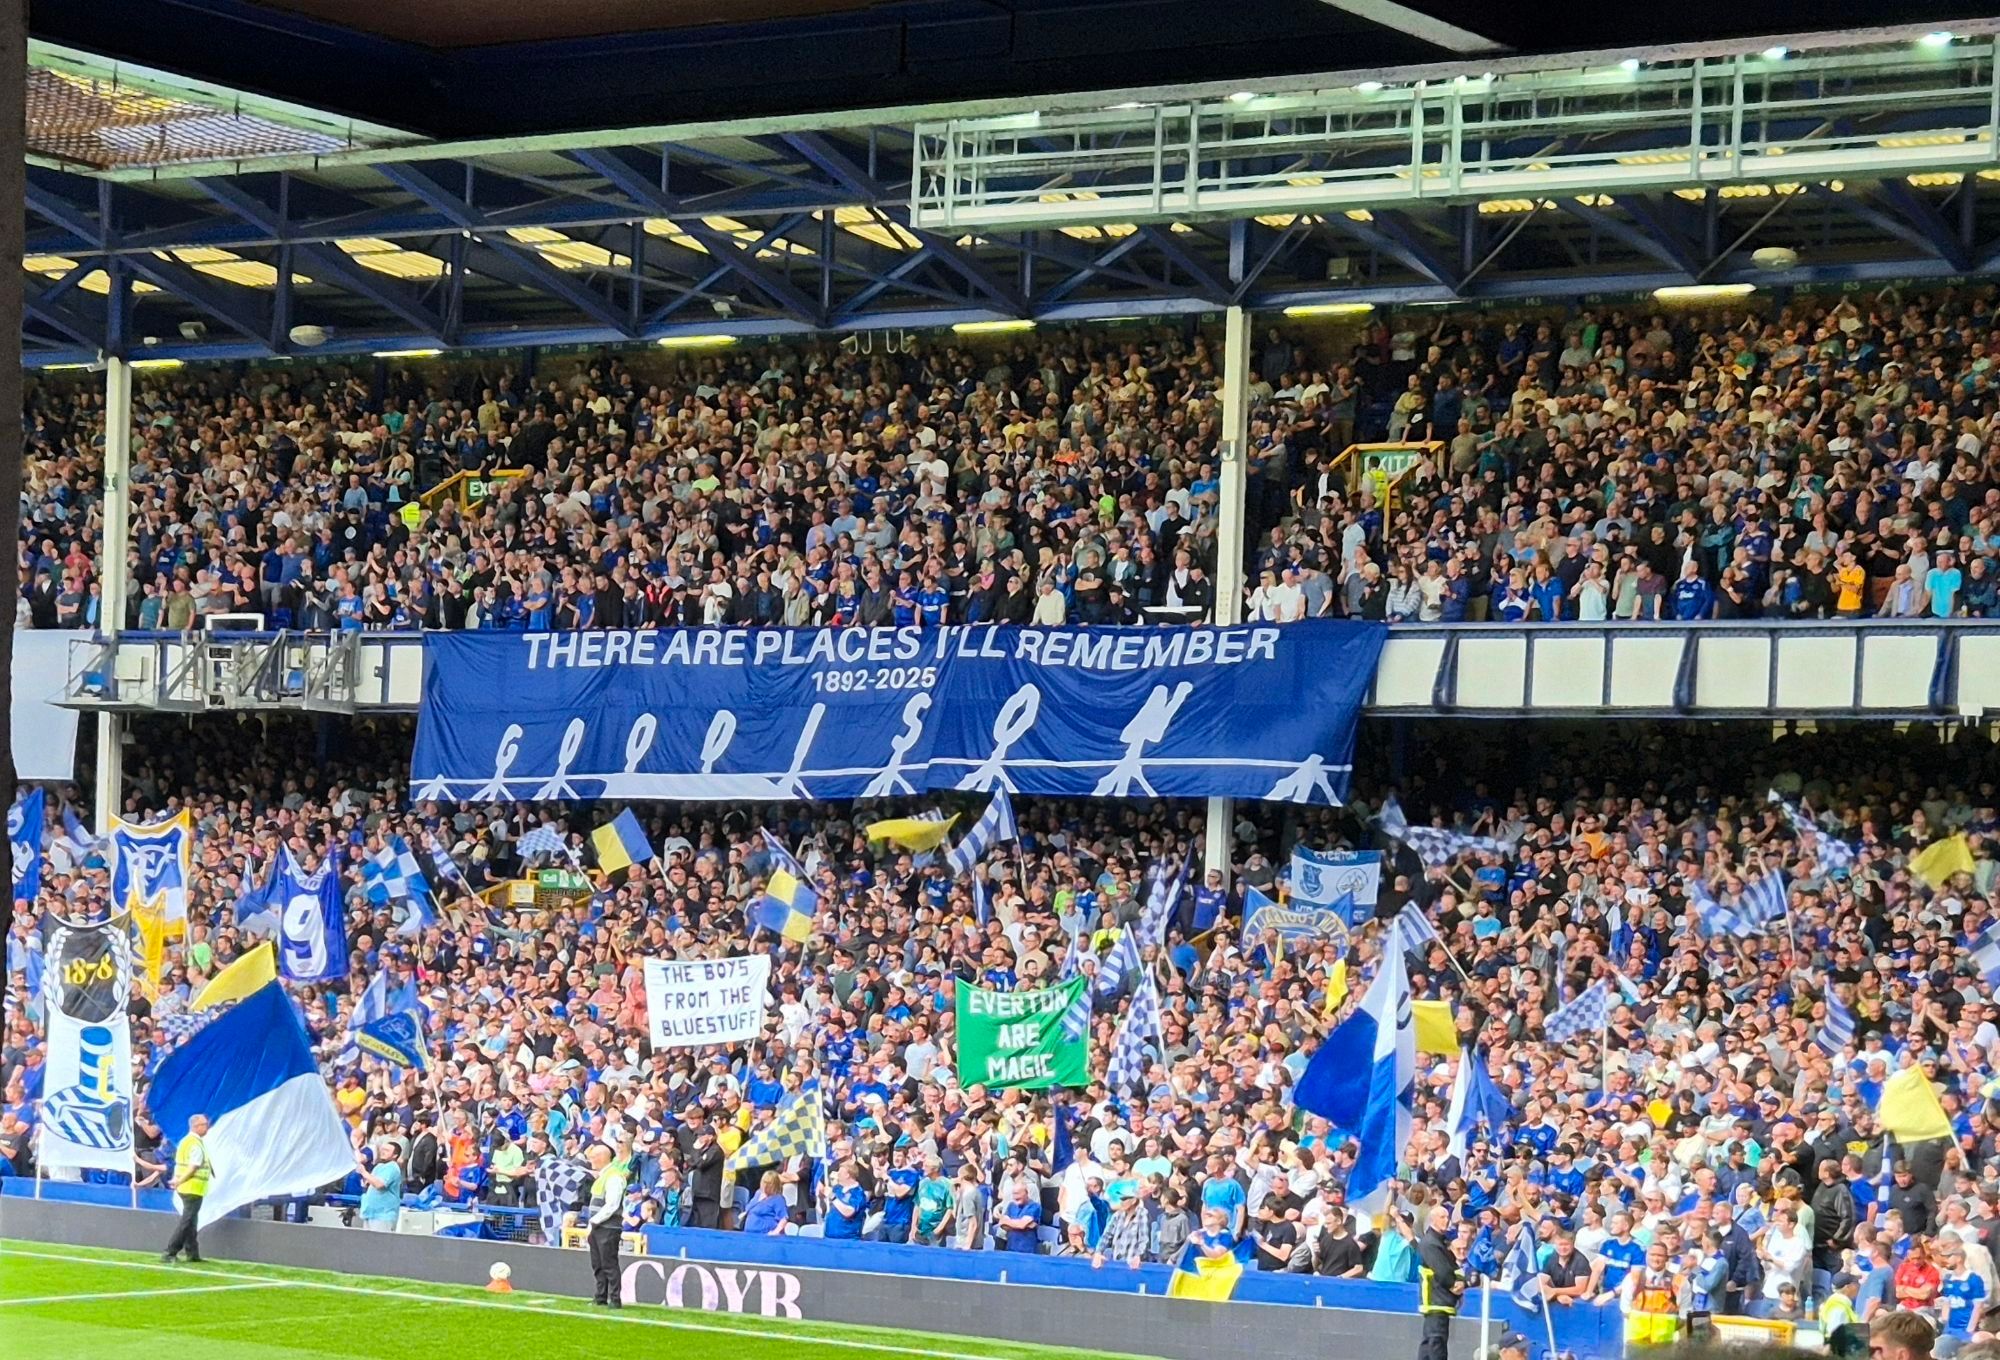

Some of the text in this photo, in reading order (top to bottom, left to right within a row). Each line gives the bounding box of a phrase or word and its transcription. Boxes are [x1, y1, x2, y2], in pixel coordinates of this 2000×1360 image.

[522, 625, 1280, 670] THERE ARE PLACES I'LL REMEMBER
[811, 666, 937, 693] 1892-2025
[282, 893, 327, 977] 9
[63, 952, 113, 986] 1878
[661, 959, 749, 984] THE BOYS
[665, 985, 751, 1010] FROM THE
[969, 989, 1069, 1017] EVERTON
[661, 1010, 757, 1037] BLUESTUFF
[998, 1023, 1041, 1049] ARE
[987, 1053, 1056, 1080] MAGIC
